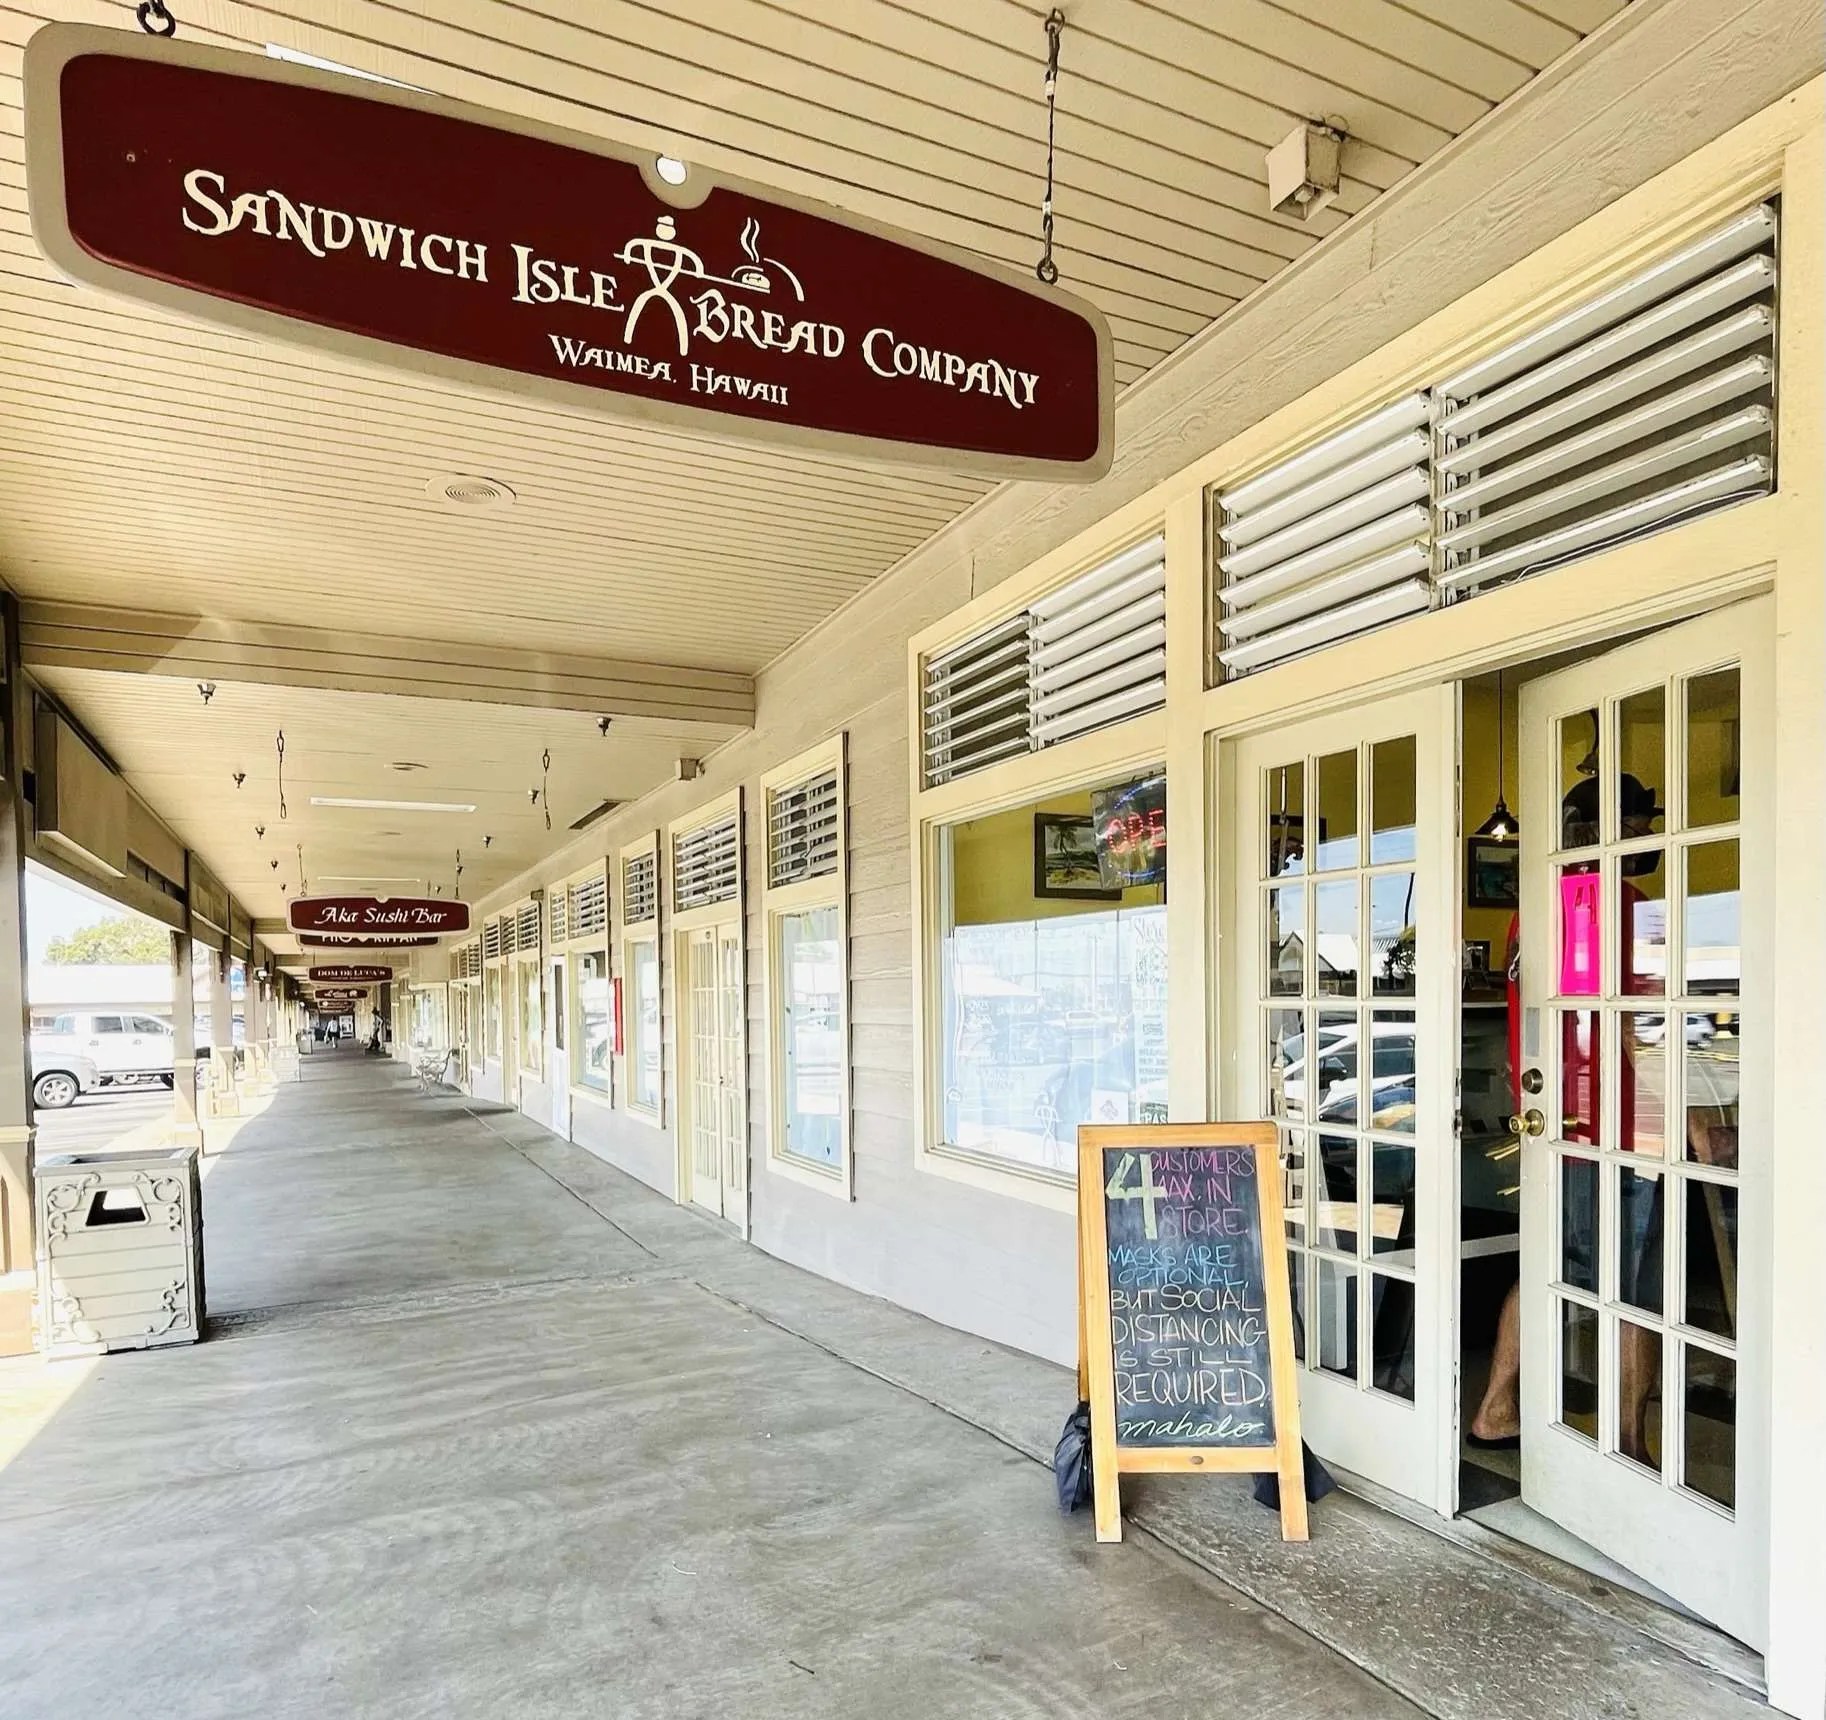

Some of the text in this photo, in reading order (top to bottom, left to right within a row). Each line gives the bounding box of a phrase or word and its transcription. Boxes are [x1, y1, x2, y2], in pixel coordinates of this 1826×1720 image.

[182, 168, 1040, 409] SANDWICH ISLE BREAD COMPANY
[689, 363, 789, 406] HAWAII
[314, 906, 447, 924] Aka Sushi Bar
[1105, 1150, 1256, 1240] 4 CUSTOMERS
[1207, 1174, 1233, 1204] IN
[1108, 1243, 1238, 1267] MASKS ARE
[1111, 1283, 1262, 1313] BUT SOCIAL
[1112, 1313, 1267, 1347] DISTANCING
[1113, 1347, 1253, 1369] IS STILL
